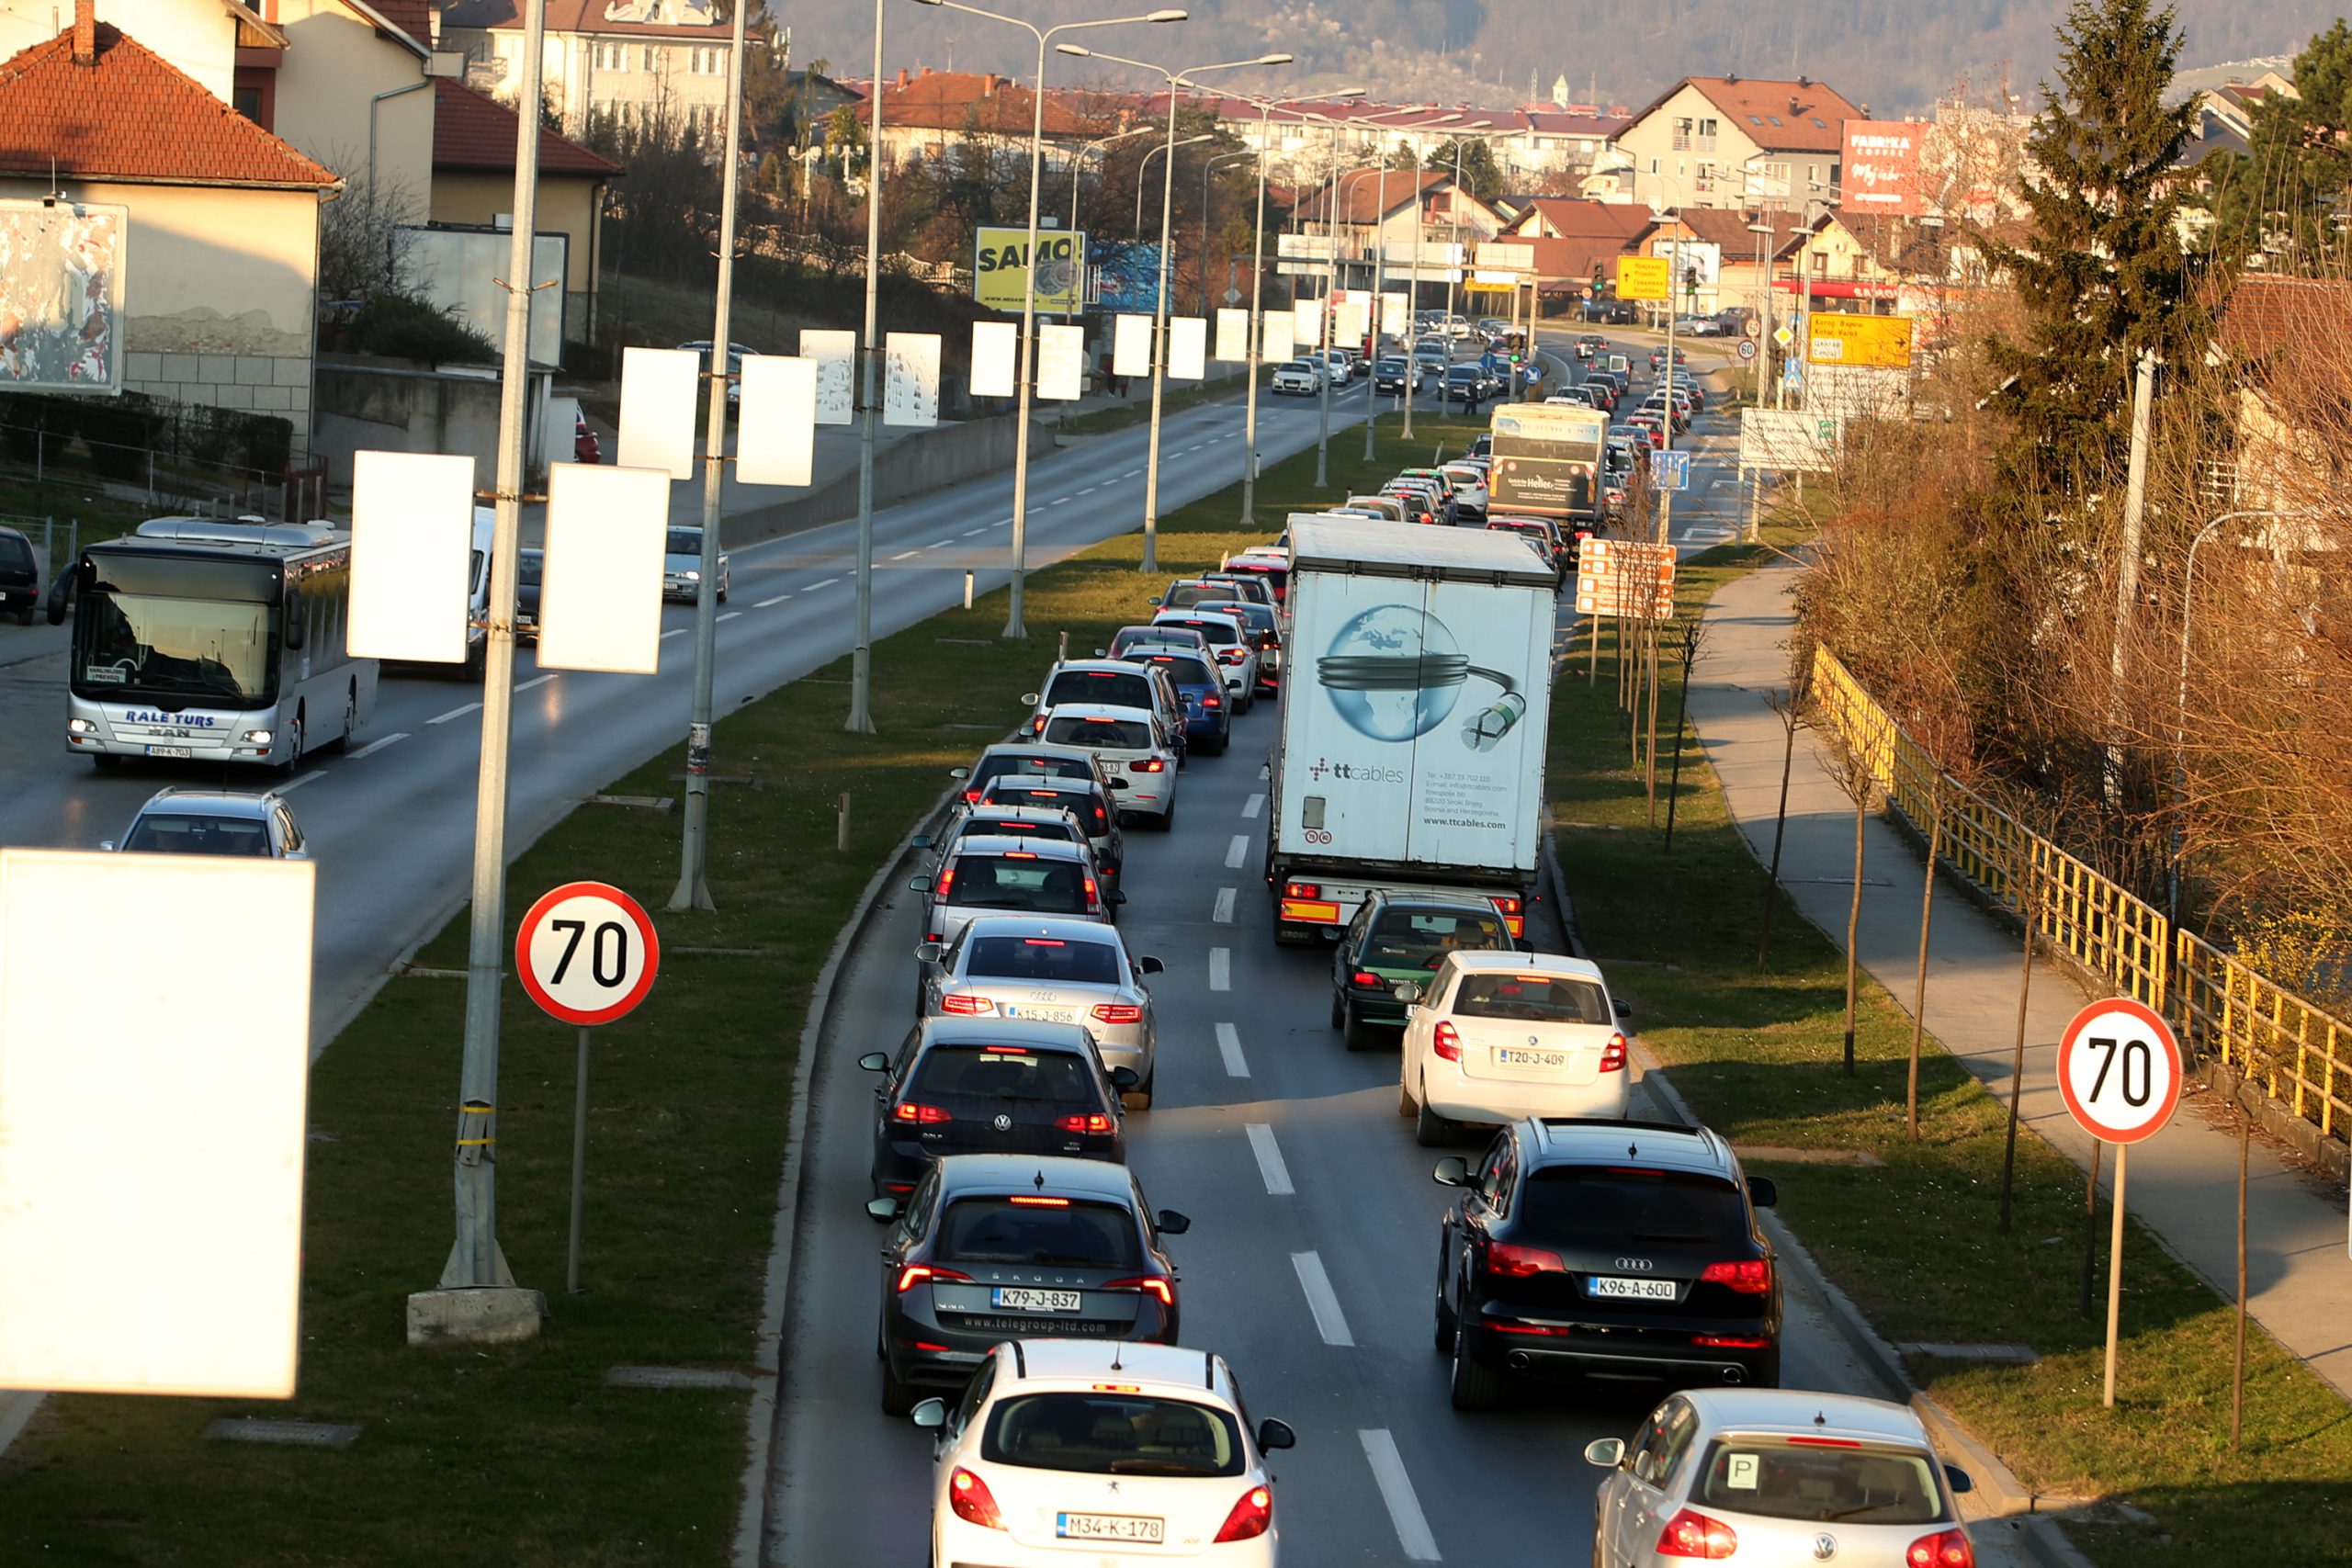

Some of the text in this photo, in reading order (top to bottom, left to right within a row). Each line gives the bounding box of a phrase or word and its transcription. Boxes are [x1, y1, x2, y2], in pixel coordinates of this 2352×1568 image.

[1850, 134, 1910, 149] FABRIKA
[1857, 148, 1904, 157] COFFEE
[1742, 344, 1753, 355] 60
[126, 710, 215, 728] RALE TURS
[148, 726, 190, 738] MAN
[1333, 763, 1404, 784] ttcables
[1423, 817, 1507, 829] www.ttcables.com
[550, 919, 628, 988] 70
[1016, 1010, 1073, 1023] K15-J-856
[1508, 1051, 1565, 1066] T20-J-409
[2088, 1037, 2152, 1108] 70
[1599, 1280, 1673, 1297] K96-A-600
[1002, 1289, 1079, 1307] K79-J-837
[964, 1315, 1107, 1333] www.telegroup-ltd.com
[1735, 1461, 1752, 1478] P
[1069, 1517, 1159, 1538] M34-K-178
